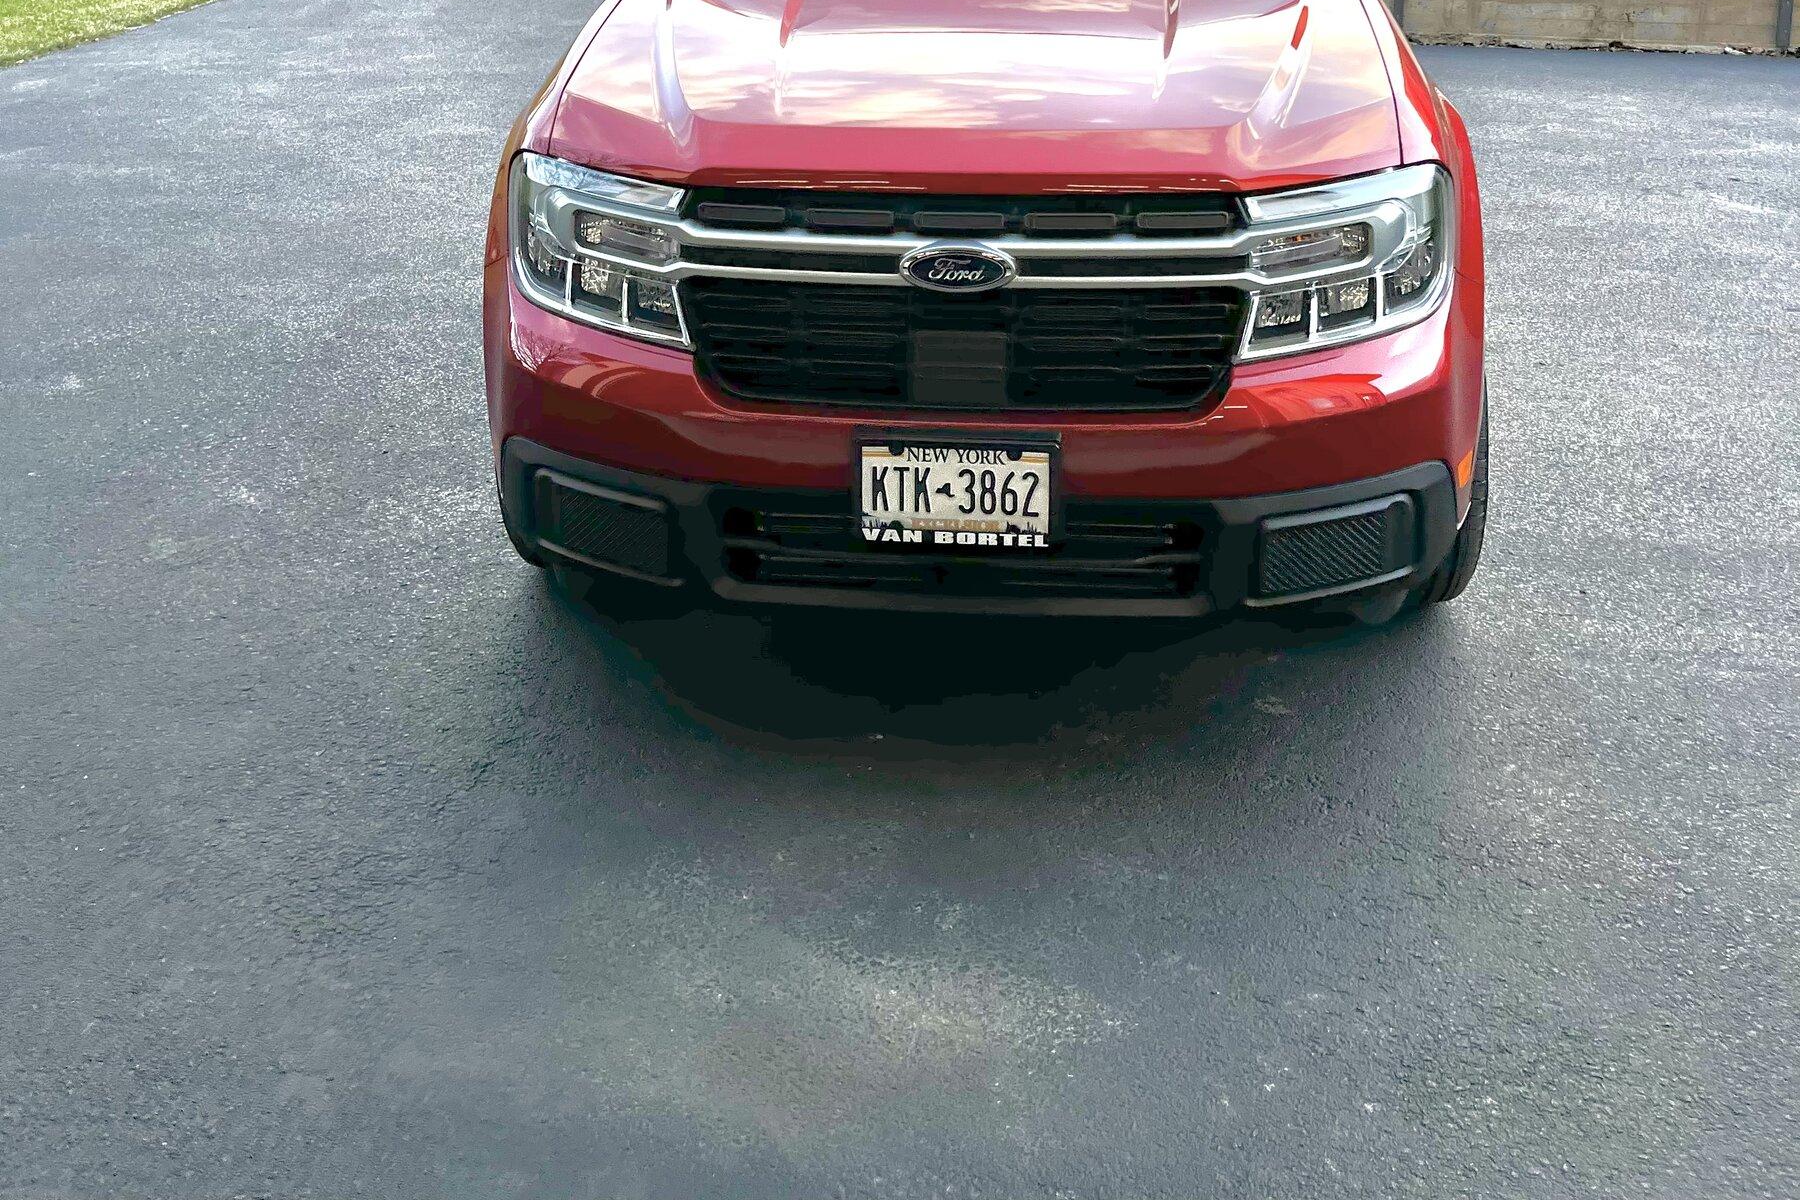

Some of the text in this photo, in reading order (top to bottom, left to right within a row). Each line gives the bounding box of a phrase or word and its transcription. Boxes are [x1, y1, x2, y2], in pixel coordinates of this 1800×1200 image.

[928, 258, 985, 281] Ford
[907, 446, 1007, 466] NEW YORK
[871, 466, 1040, 517] KTK 3862
[861, 528, 1049, 548] VAN BORTEL
